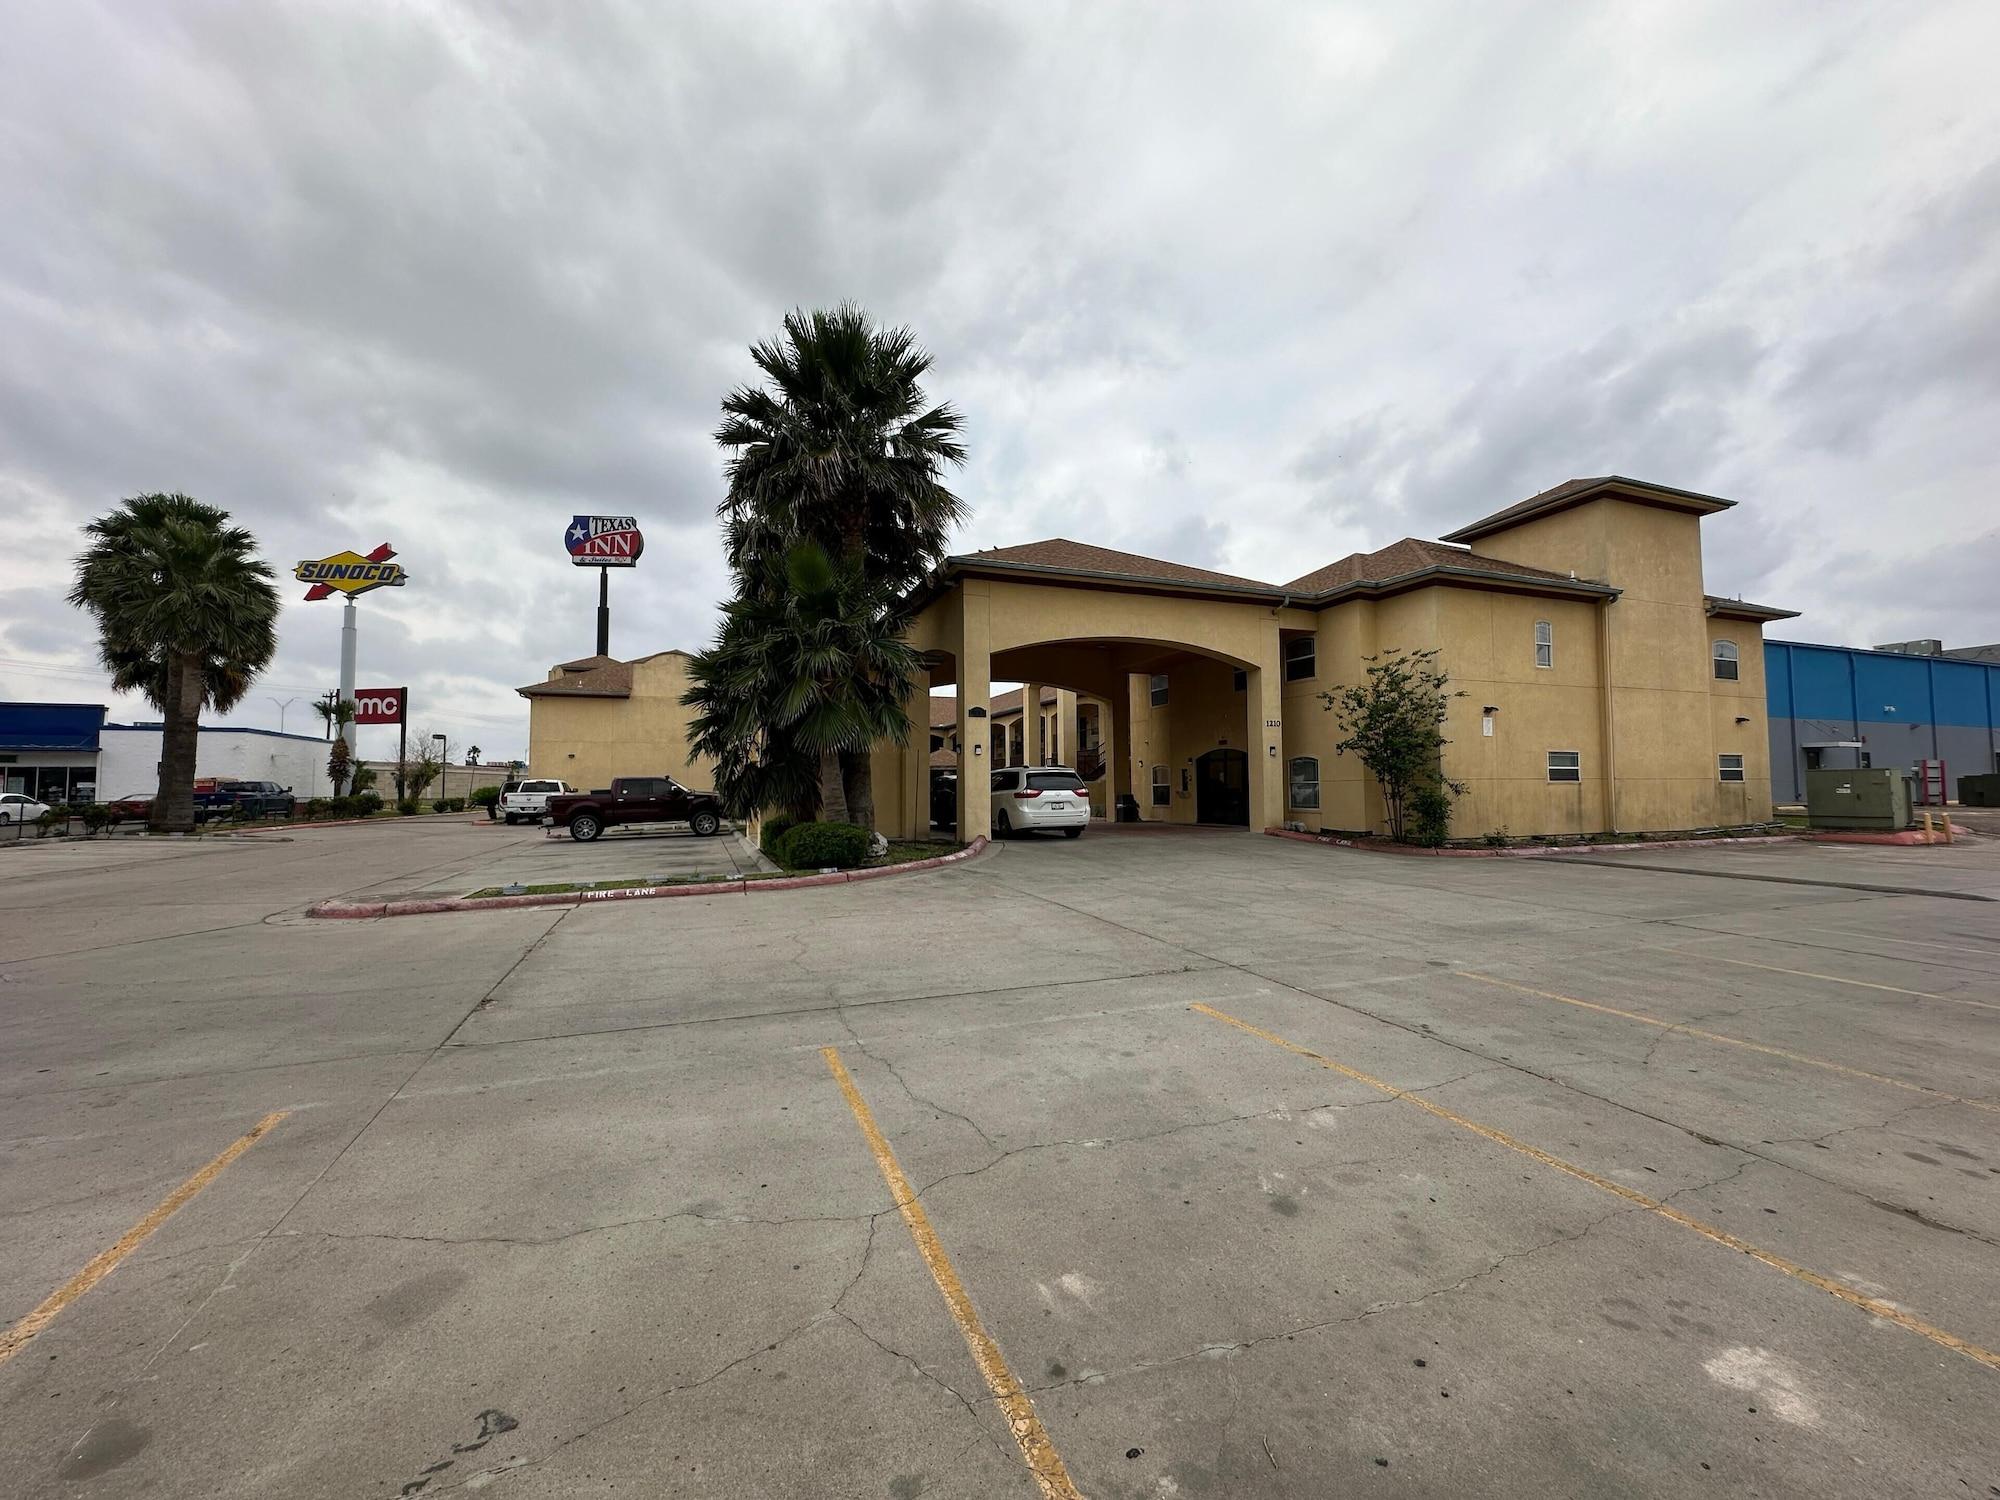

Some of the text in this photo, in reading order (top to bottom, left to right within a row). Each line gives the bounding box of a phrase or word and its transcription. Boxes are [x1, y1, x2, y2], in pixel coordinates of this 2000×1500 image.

[592, 518, 632, 535] TEXAS
[584, 533, 633, 555] INN
[300, 563, 396, 580] SUNOCO
[355, 697, 398, 715] mc
[587, 887, 656, 898] FIRE LANE
